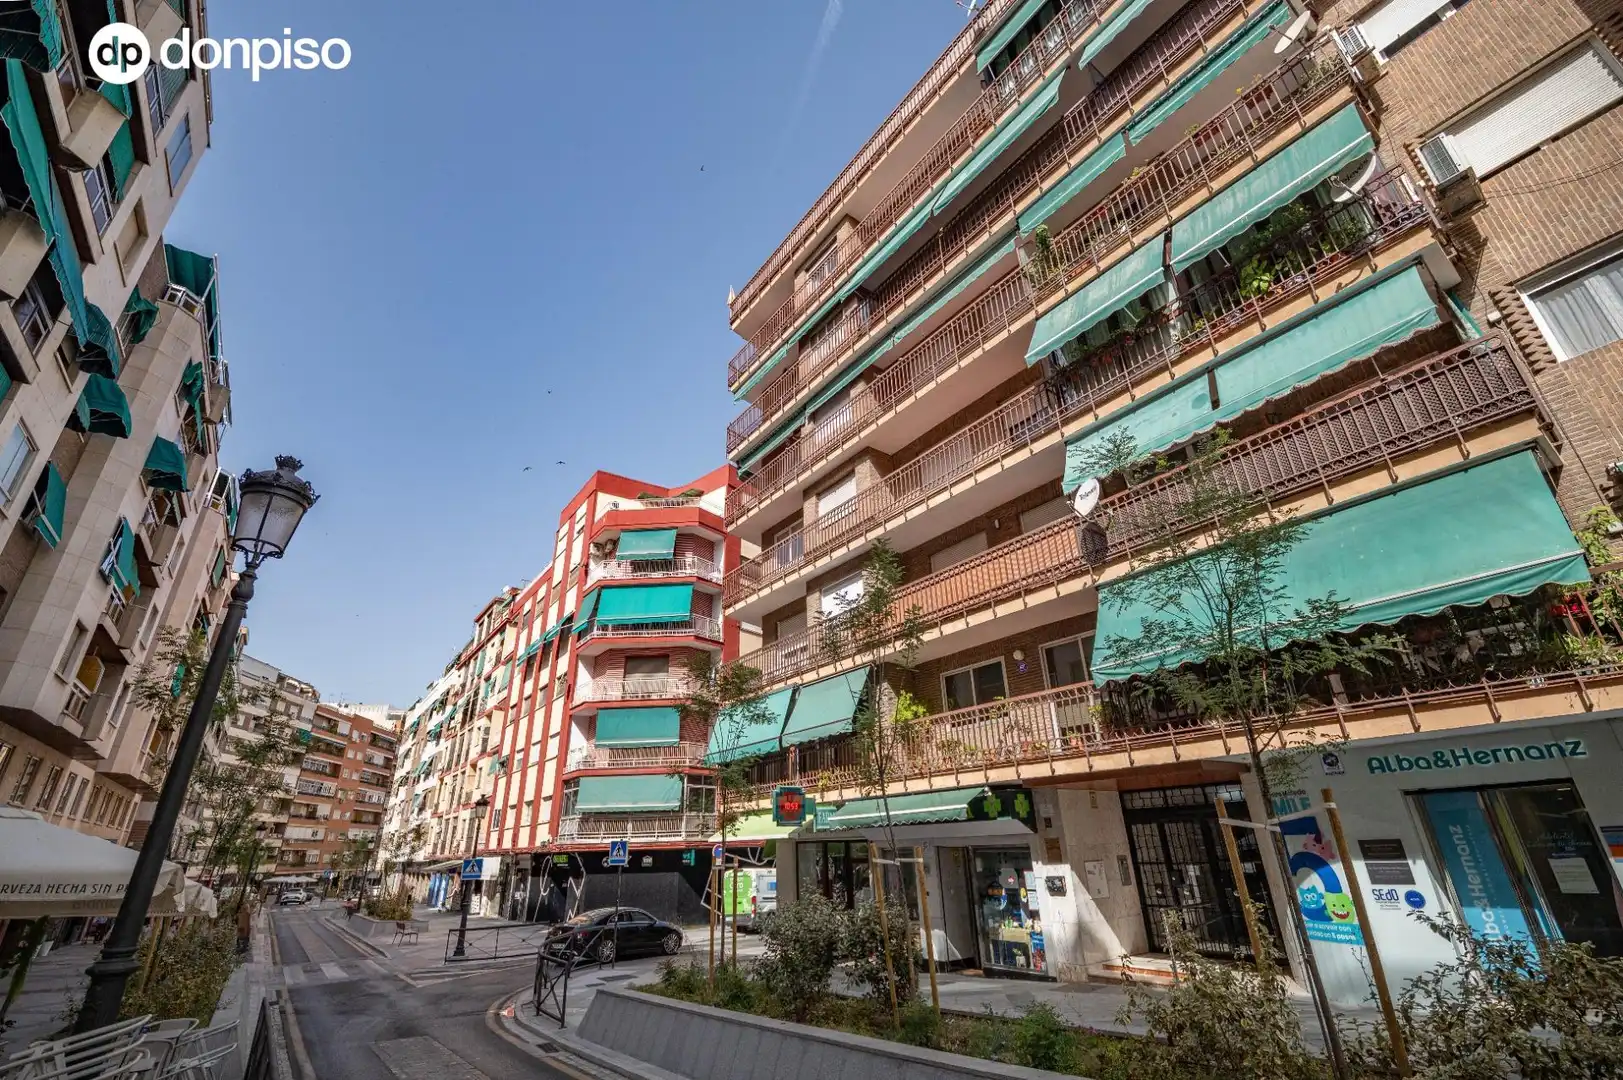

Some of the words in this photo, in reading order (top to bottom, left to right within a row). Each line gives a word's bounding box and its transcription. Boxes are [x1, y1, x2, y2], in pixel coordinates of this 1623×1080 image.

[1366, 740, 1588, 775] Alba&Hernanz
[0, 883, 41, 895] RVEZA
[45, 883, 88, 895] HECHA
[90, 883, 112, 895] SIN
